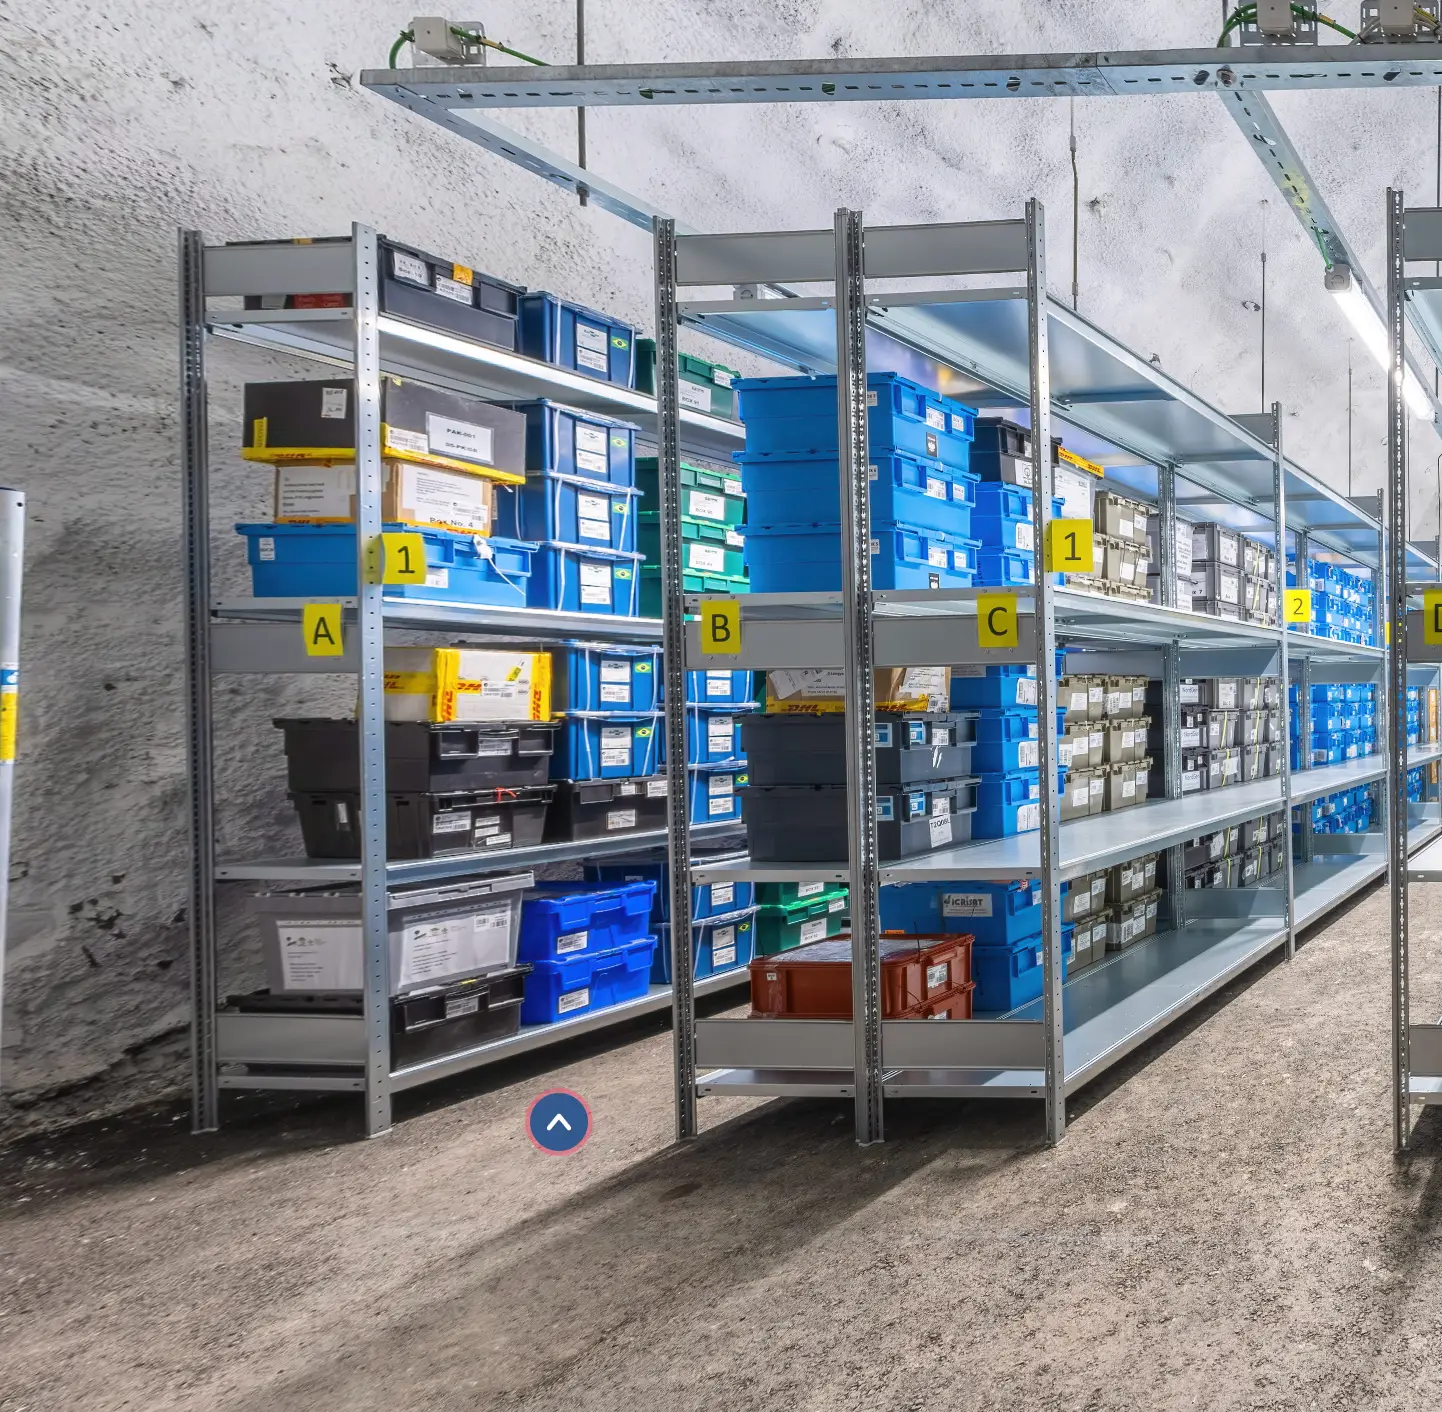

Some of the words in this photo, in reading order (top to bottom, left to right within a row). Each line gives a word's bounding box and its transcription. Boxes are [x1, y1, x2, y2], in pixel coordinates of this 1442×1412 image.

[397, 545, 416, 574] 1
[1064, 531, 1082, 561] 1
[987, 606, 1008, 636] C
[1293, 598, 1304, 615] 2
[313, 616, 336, 645] A
[711, 613, 731, 643] B
[787, 704, 820, 712] DHL
